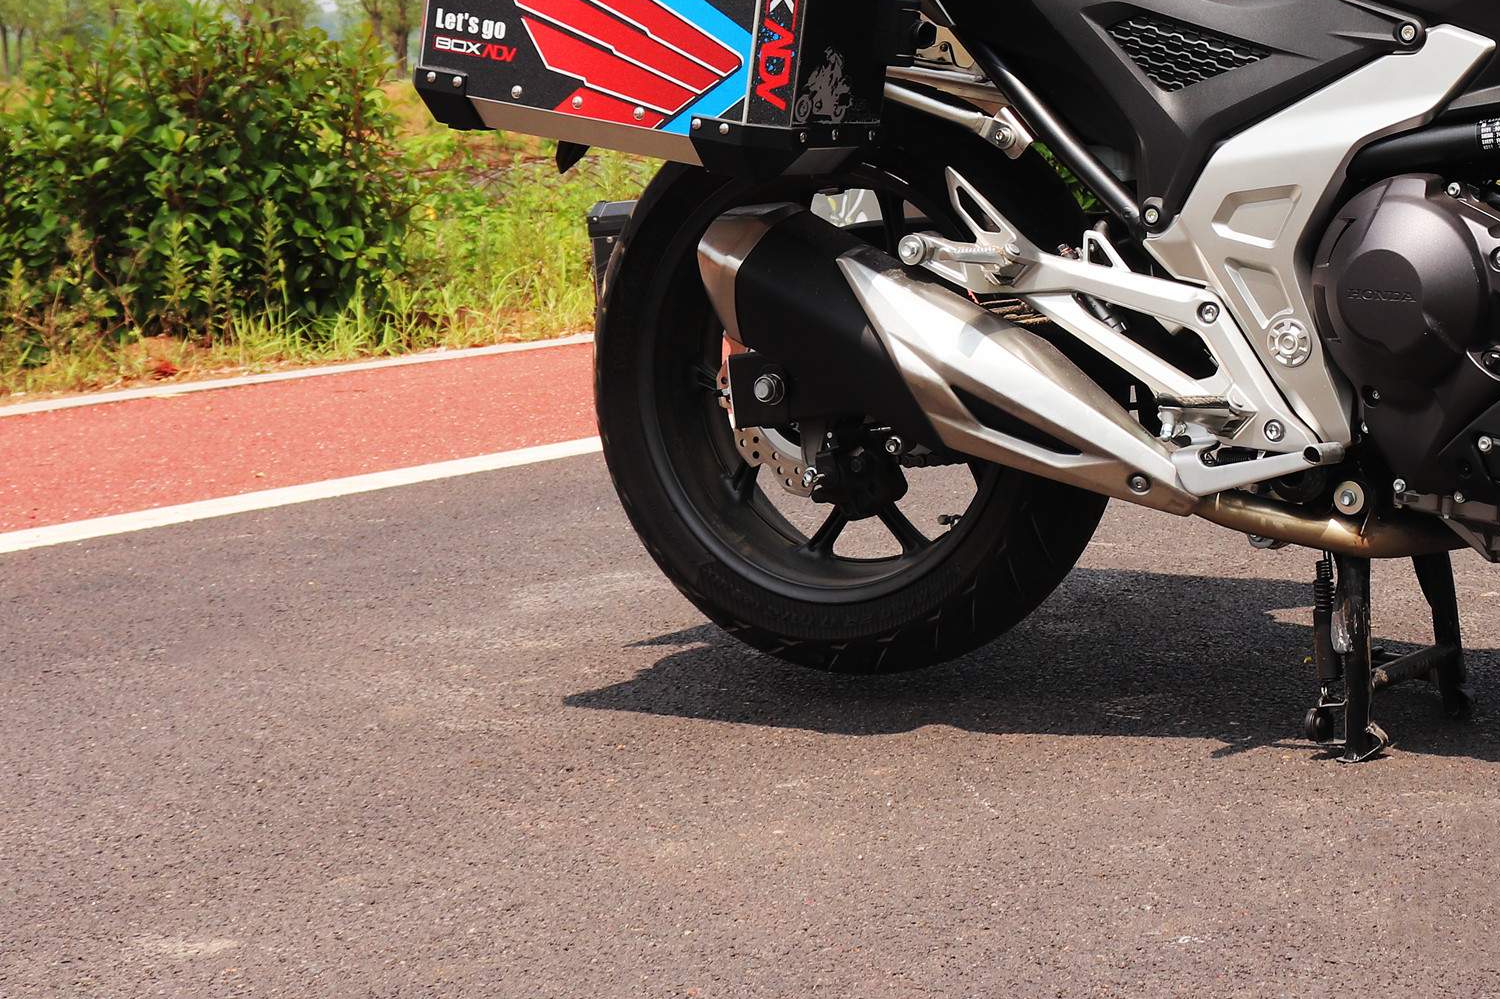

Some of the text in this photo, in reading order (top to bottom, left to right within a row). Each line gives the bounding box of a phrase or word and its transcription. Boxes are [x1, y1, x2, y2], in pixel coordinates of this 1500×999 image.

[435, 7, 506, 40] Let's go
[435, 36, 517, 62] BOX ADV
[756, 16, 796, 112] ADV
[1344, 288, 1417, 303] HONDA
